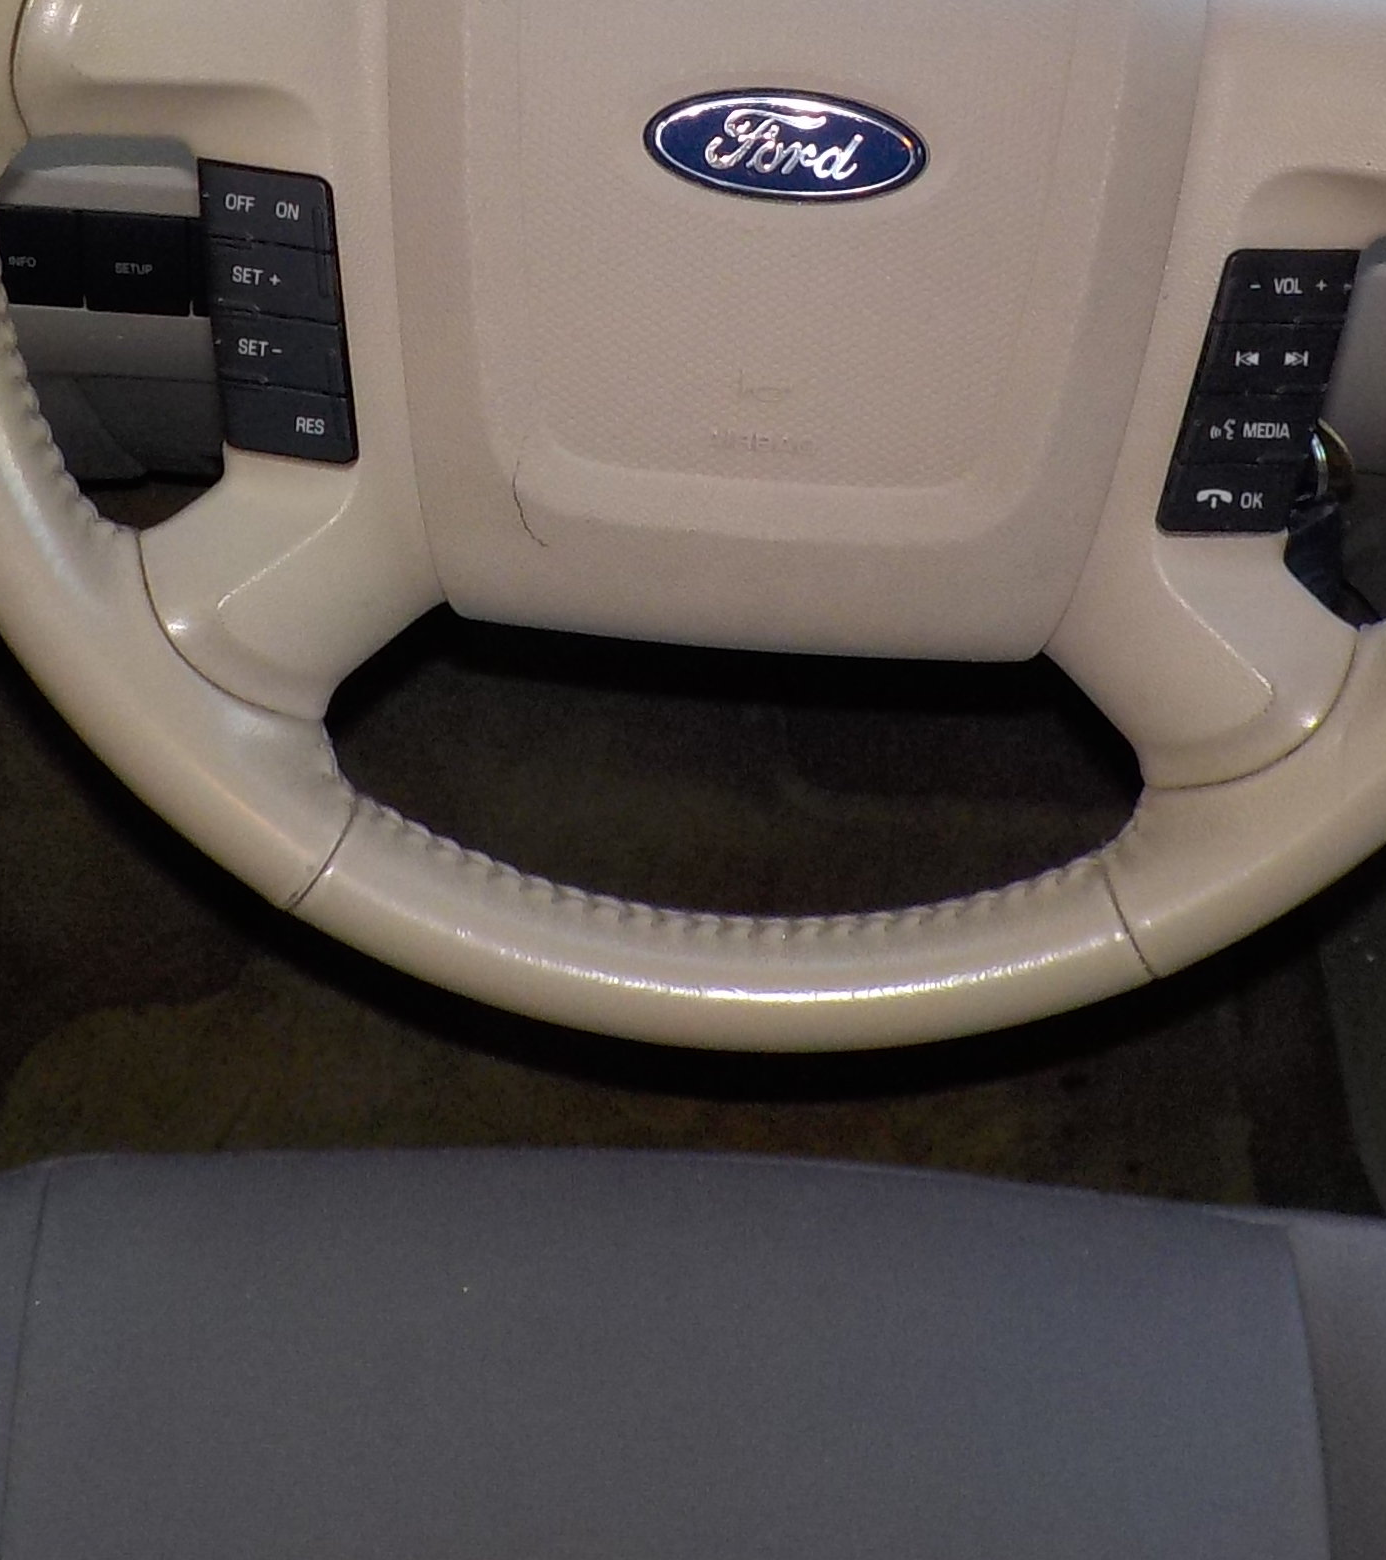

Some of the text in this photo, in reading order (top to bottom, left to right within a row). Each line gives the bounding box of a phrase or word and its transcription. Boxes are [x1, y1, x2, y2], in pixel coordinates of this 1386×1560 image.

[705, 108, 864, 181] Ford
[224, 192, 301, 222] OFF ON
[114, 261, 154, 275] SETUP
[231, 266, 263, 286] SET
[1273, 277, 1303, 295] VOL
[237, 338, 269, 358] SET
[295, 416, 325, 435] RES
[1242, 422, 1291, 439] MEDIA
[1240, 492, 1264, 509] OK
